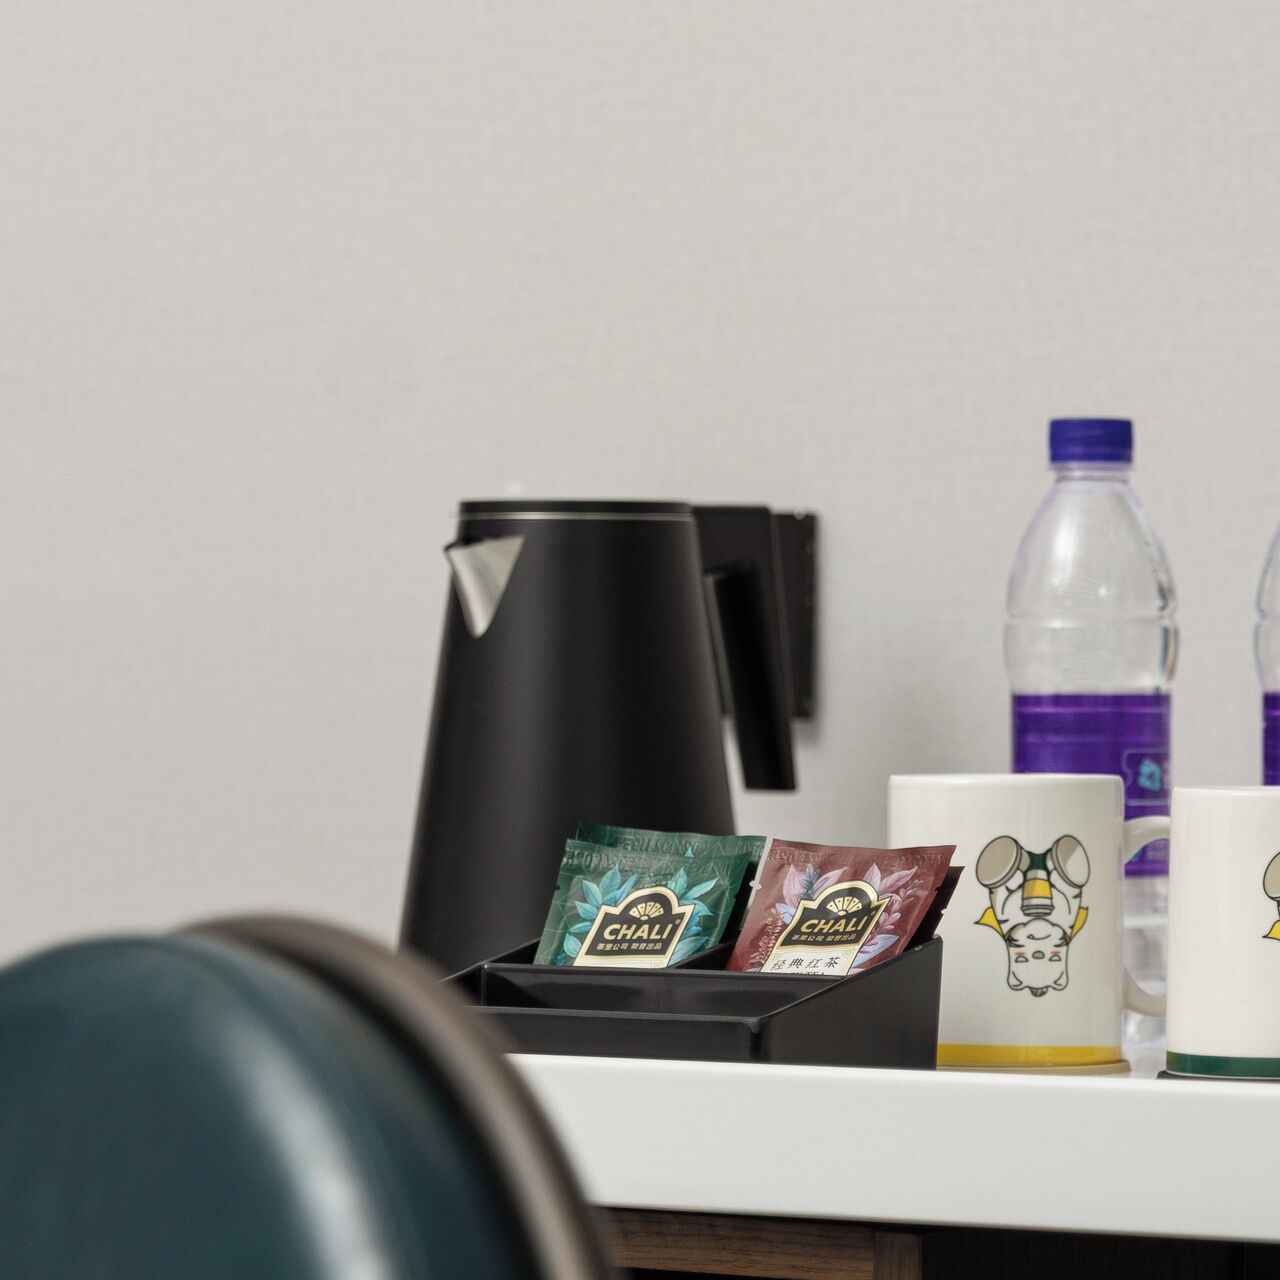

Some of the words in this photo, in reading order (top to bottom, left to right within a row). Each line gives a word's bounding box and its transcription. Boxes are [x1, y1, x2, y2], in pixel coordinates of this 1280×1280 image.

[603, 924, 673, 940] CHALI
[800, 916, 868, 933] CHALI
[771, 956, 841, 971] 经典红茶
